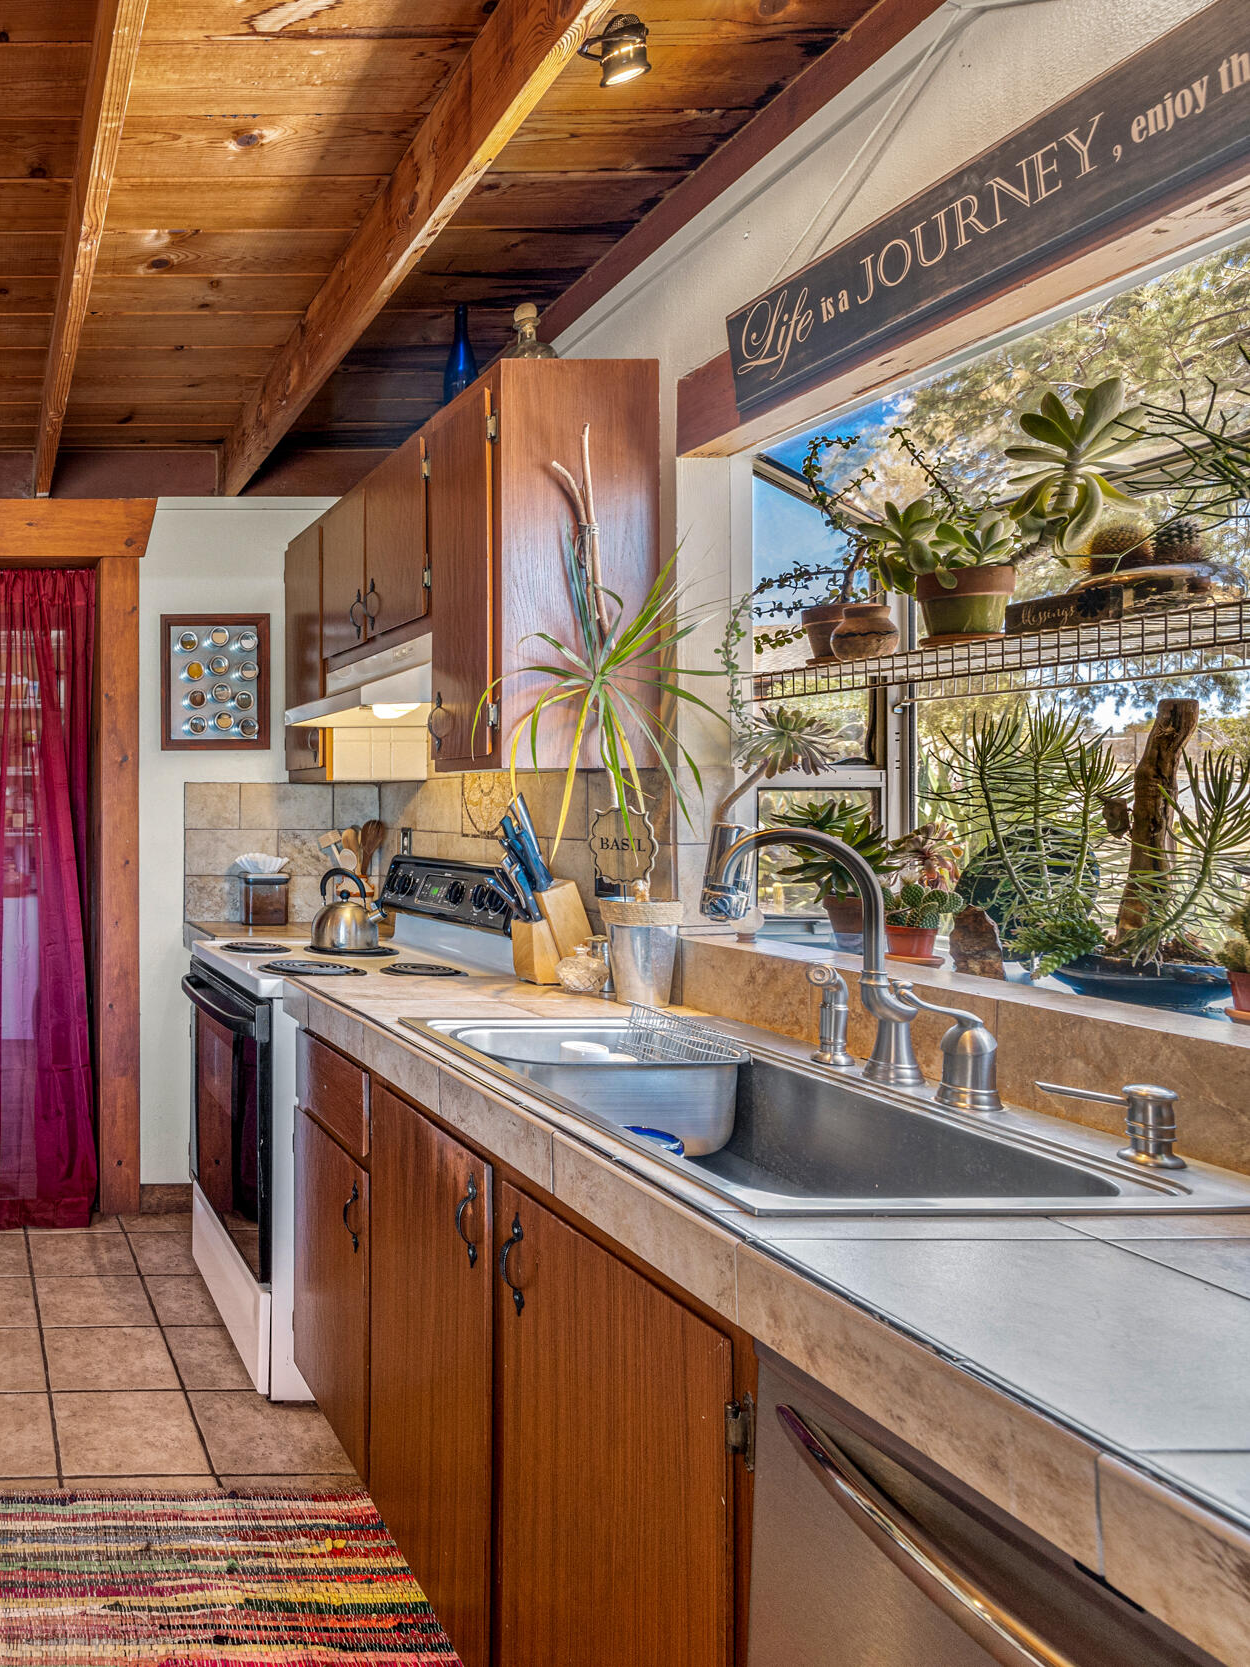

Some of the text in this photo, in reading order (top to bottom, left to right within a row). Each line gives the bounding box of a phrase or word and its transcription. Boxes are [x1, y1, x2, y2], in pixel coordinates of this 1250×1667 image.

[737, 287, 815, 380] Life
[820, 296, 835, 323] is
[837, 289, 850, 313] a
[1131, 75, 1209, 144] enjoy
